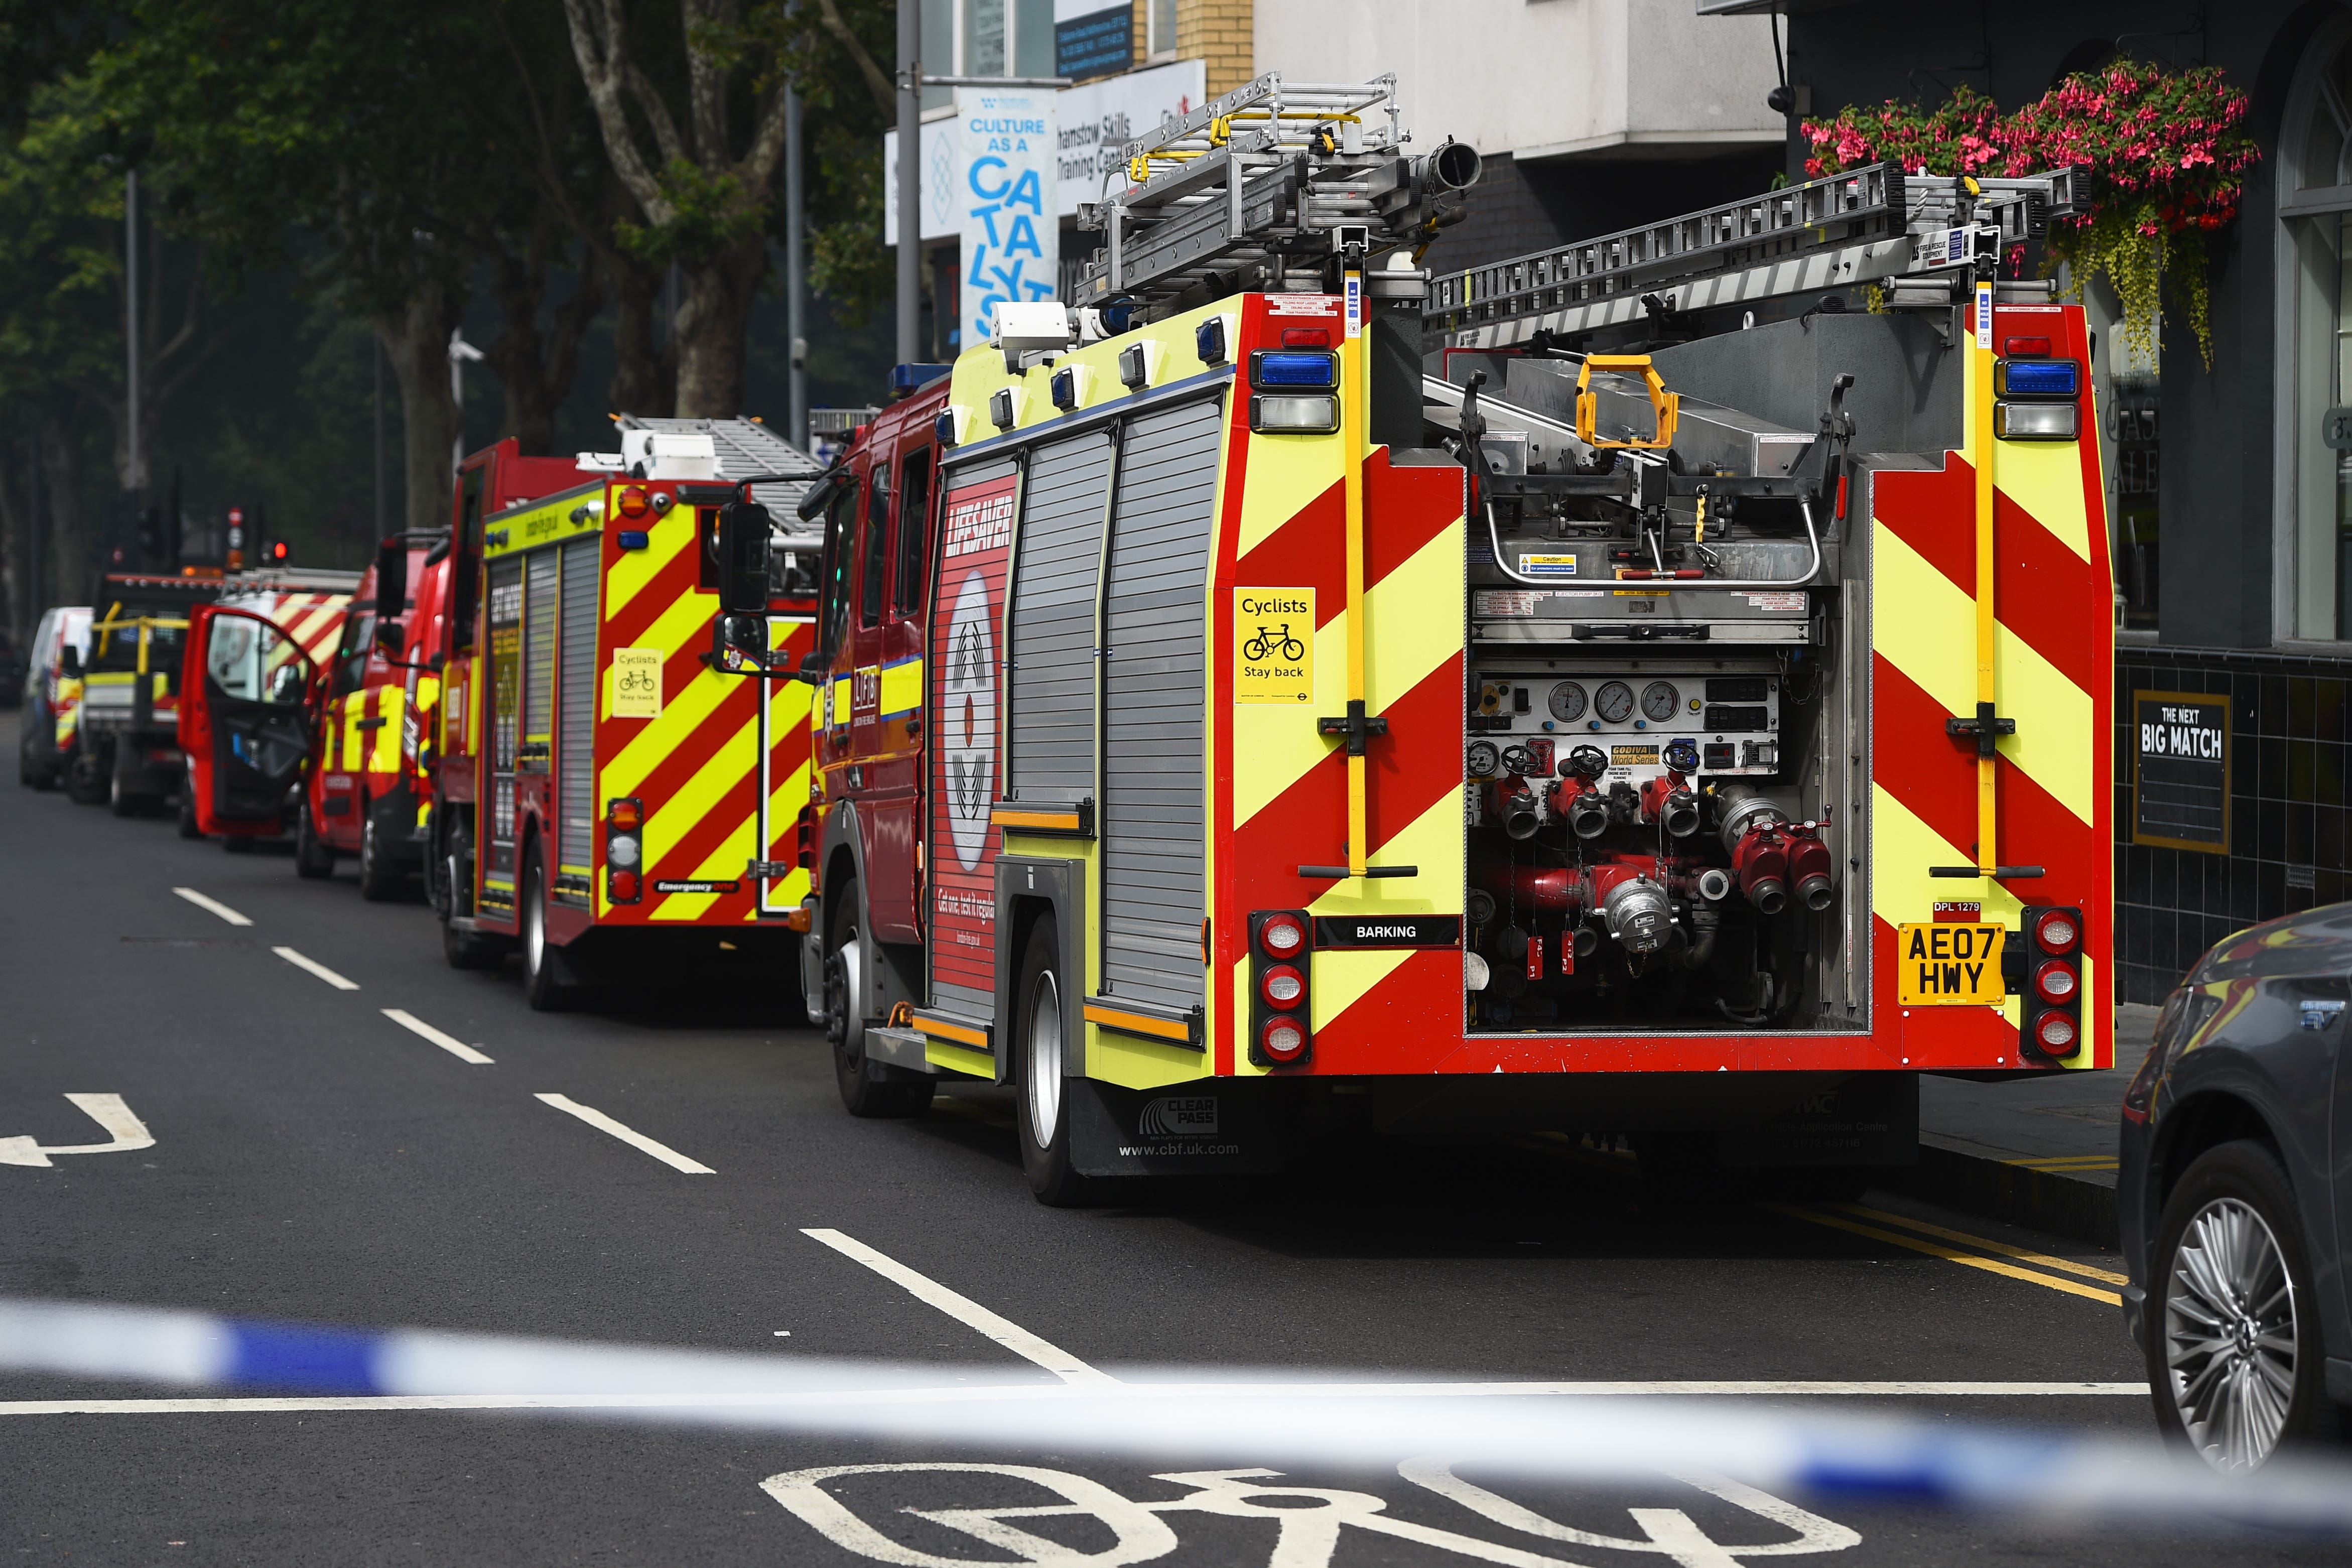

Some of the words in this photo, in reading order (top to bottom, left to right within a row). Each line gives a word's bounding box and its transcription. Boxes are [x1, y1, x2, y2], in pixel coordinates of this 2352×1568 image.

[970, 118, 1045, 134] CULTURE
[1102, 110, 1131, 139] Skills
[988, 137, 1011, 152] AS
[1016, 137, 1028, 152] A
[945, 494, 1013, 558] LIFESAVER
[1242, 598, 1308, 617] Cyclists
[618, 654, 657, 665] Cyclists
[1244, 666, 1271, 679] Stay
[1274, 667, 1304, 677] back
[2162, 707, 2176, 723] THE
[2178, 707, 2199, 725] NEXT
[2141, 723, 2165, 753] BIG
[2170, 726, 2222, 759] MATCH
[1612, 755, 1633, 764] World
[1635, 755, 1659, 764] Series
[938, 888, 948, 912] Get
[948, 895, 960, 916] one,
[960, 892, 971, 916] test
[971, 891, 976, 916] it
[1934, 902, 1954, 911] DPL
[1957, 902, 1980, 911] 1279
[1357, 926, 1416, 938] BARKING
[1908, 928, 1996, 960] AE07
[1529, 965, 1535, 978] P1
[1562, 958, 1567, 972] P2
[1919, 962, 1984, 994] HWY
[1167, 1099, 1214, 1111] CLEAR
[1178, 1112, 1214, 1123] PASS
[1799, 1121, 1852, 1135] Application
[1856, 1121, 1888, 1132] Centre
[1119, 1142, 1239, 1156] www.cbf.uk.com
